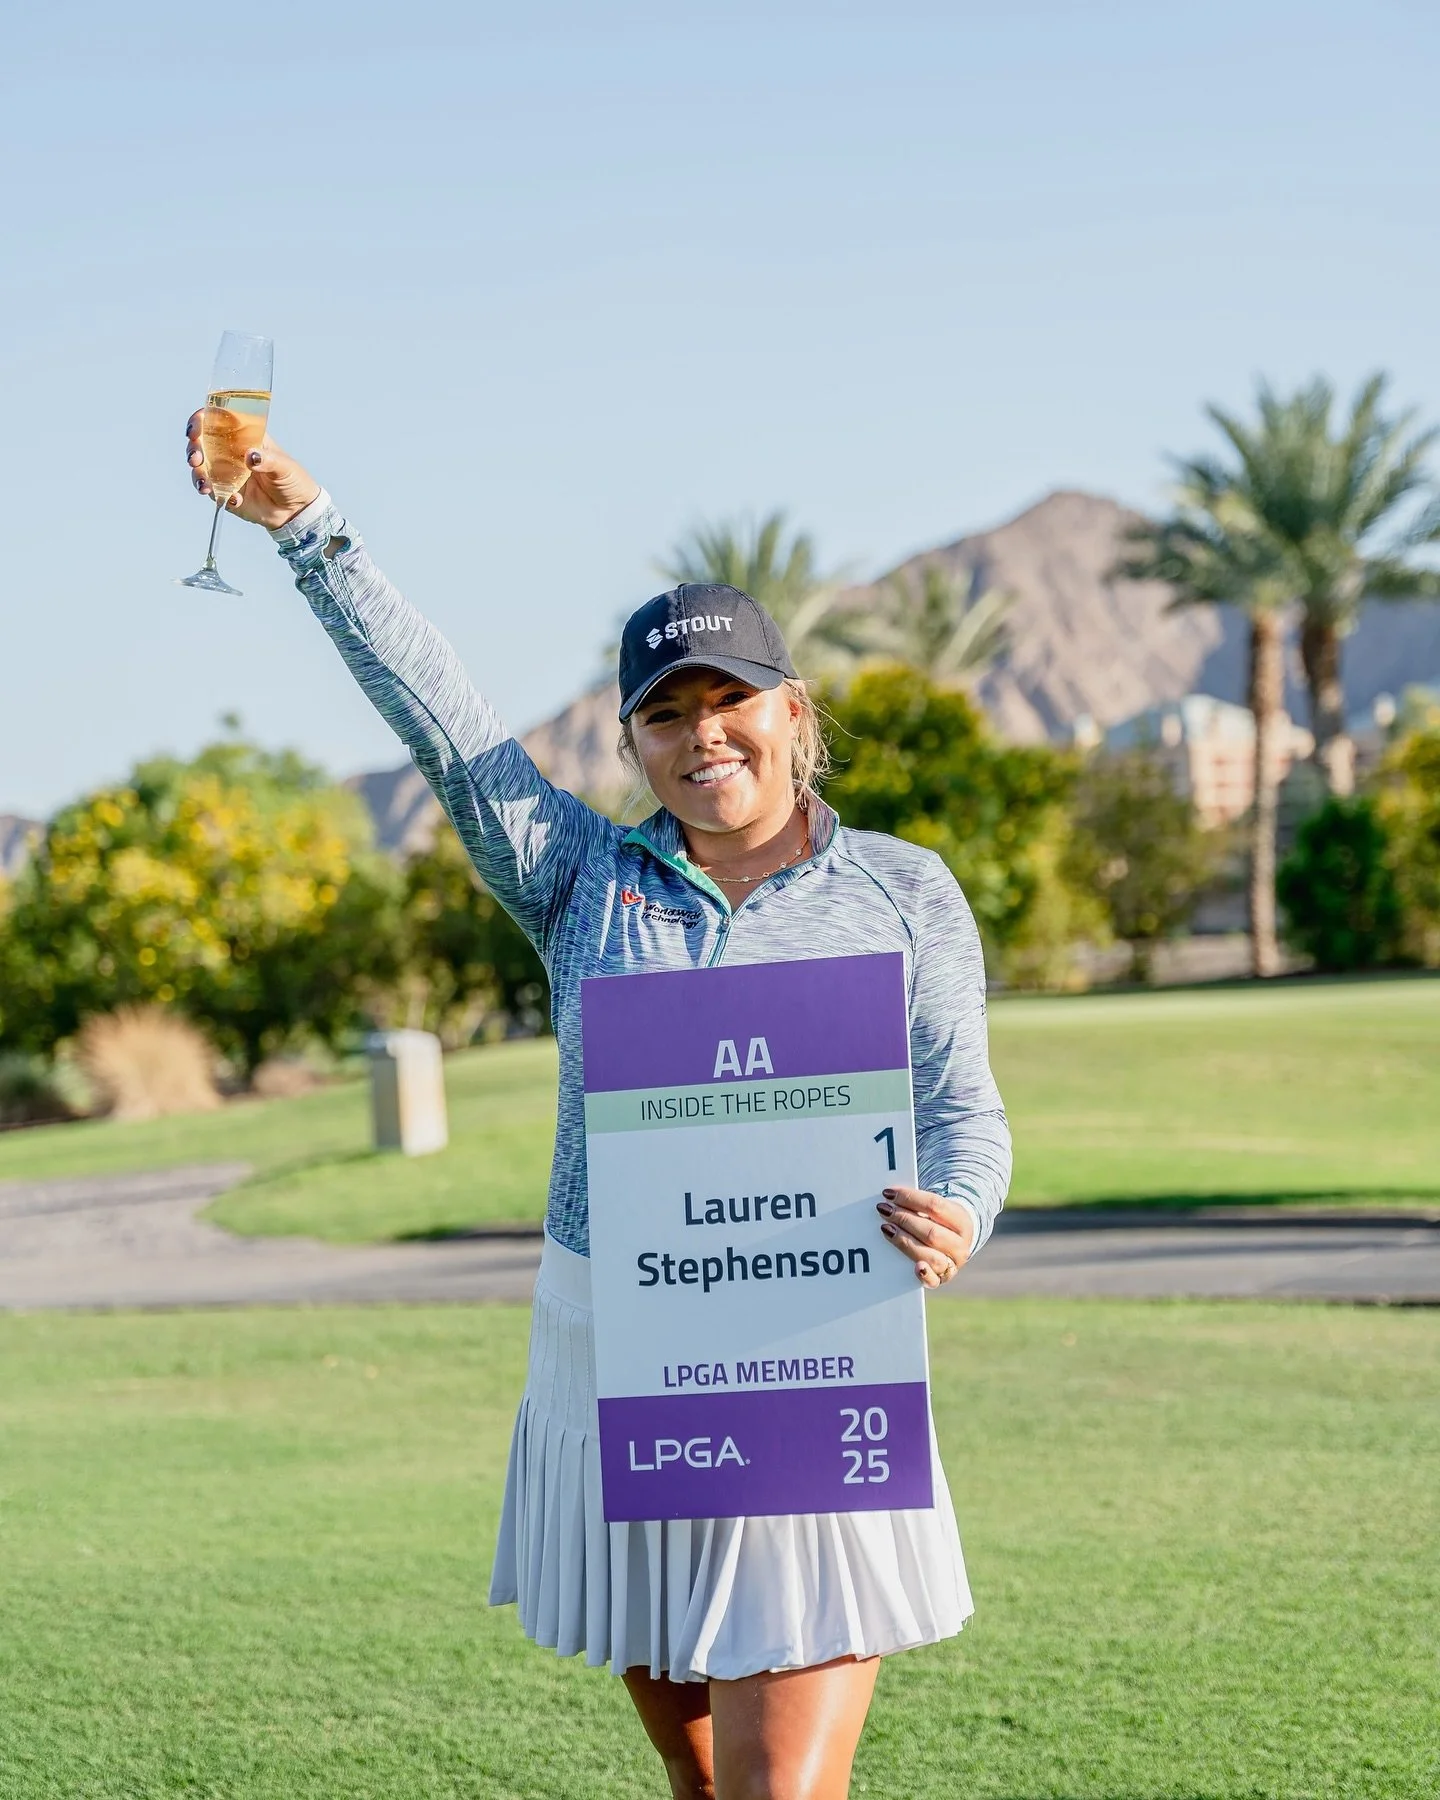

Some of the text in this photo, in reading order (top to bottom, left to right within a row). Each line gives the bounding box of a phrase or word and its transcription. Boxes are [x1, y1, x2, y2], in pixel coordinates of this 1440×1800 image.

[664, 615, 733, 640] STOUT
[641, 912, 699, 930] Technology
[713, 1036, 775, 1079] AA
[641, 1085, 851, 1121] INSIDE THE ROPES
[873, 1126, 897, 1171] 1
[684, 1191, 817, 1226] Lauren
[637, 1246, 870, 1293] Stephenson
[663, 1356, 855, 1388] LPGA MEMBER
[839, 1406, 889, 1443] 20
[629, 1436, 746, 1471] LPGA
[842, 1448, 891, 1484] 25
